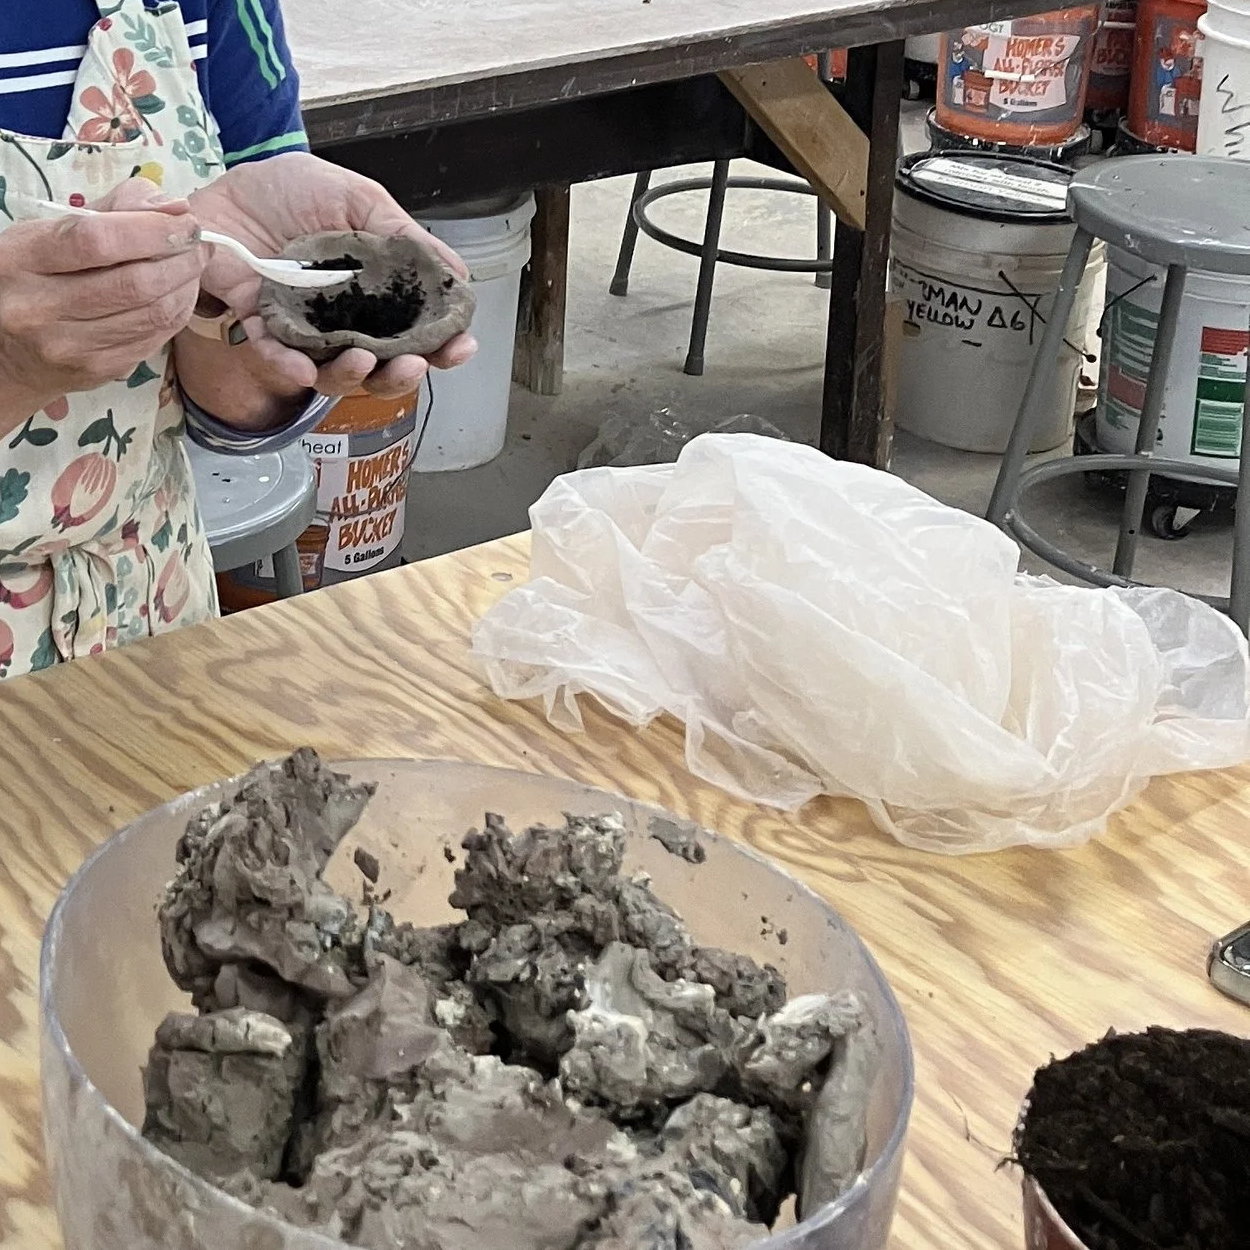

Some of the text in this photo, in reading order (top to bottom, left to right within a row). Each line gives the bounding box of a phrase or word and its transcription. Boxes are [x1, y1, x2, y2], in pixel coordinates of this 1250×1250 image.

[906, 299, 976, 330] YELLOW
[299, 439, 342, 454] heat
[337, 508, 398, 551] BUCKET
[344, 546, 384, 564] 5 Gallons
